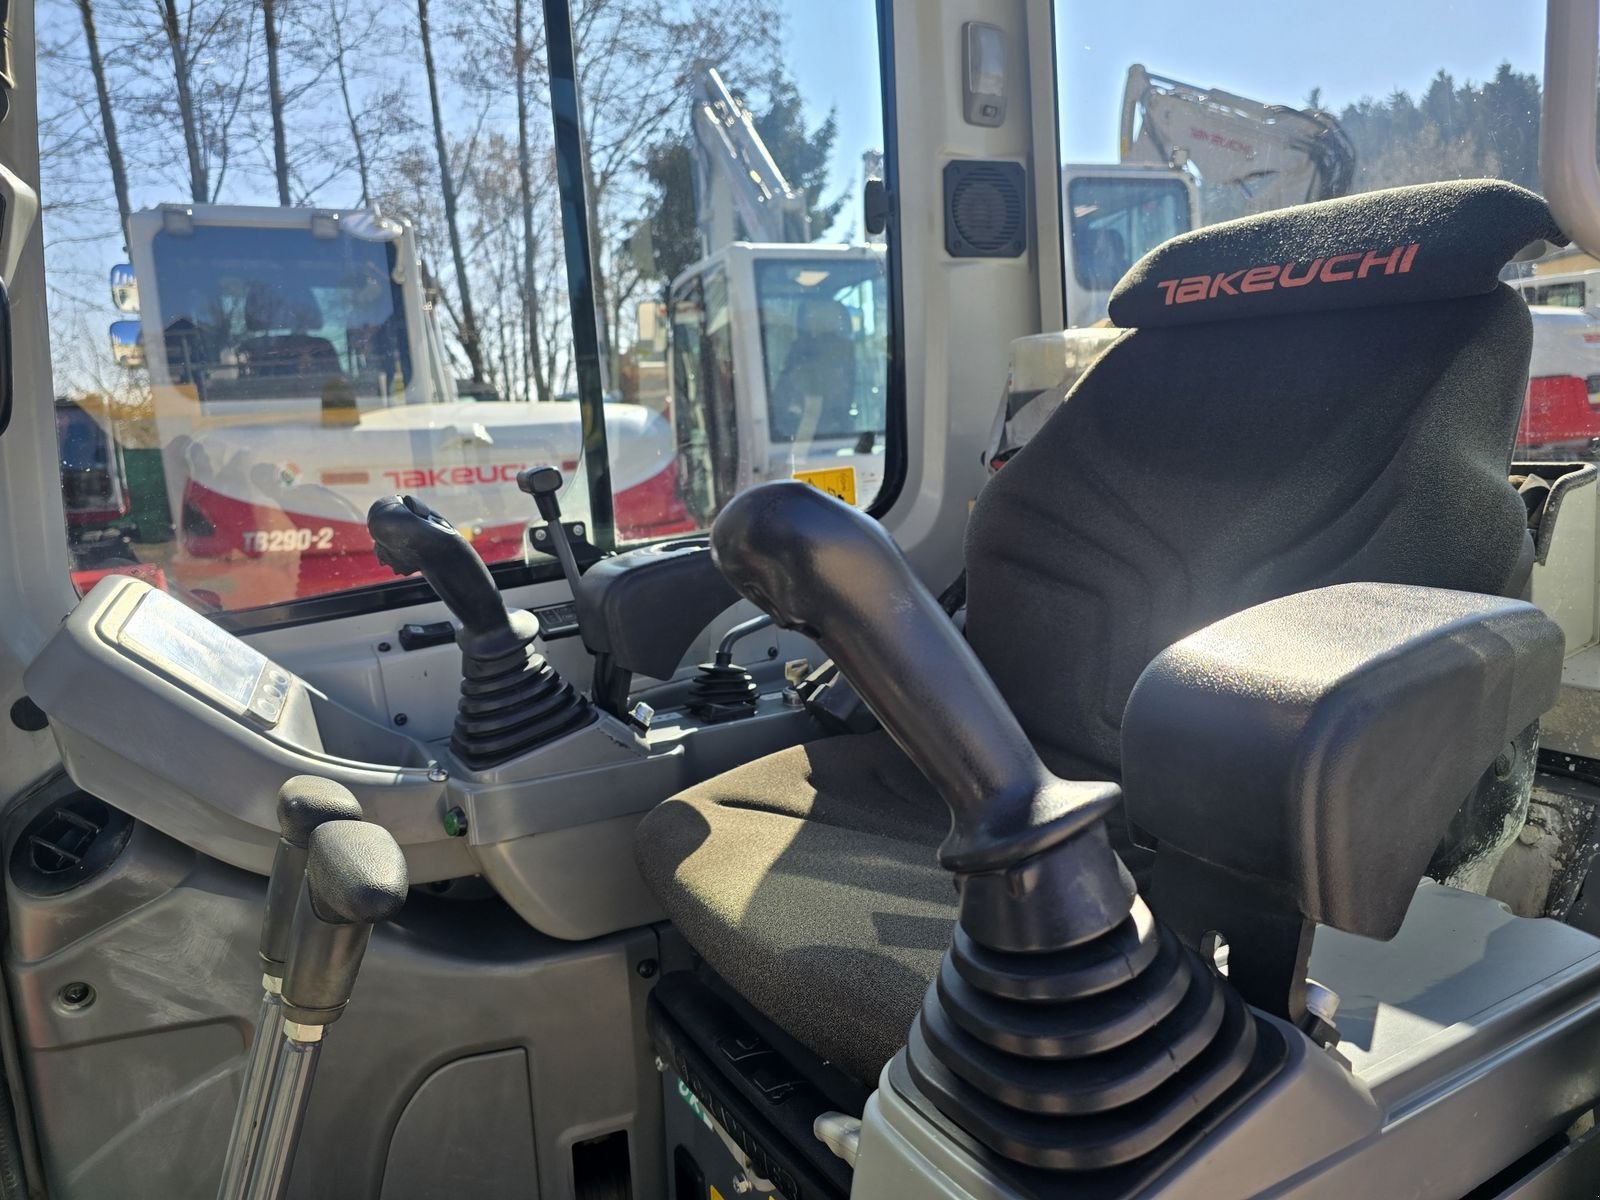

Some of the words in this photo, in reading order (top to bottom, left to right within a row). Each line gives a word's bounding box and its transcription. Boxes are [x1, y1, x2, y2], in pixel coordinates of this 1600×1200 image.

[1157, 243, 1420, 306] TAKEUCHI
[384, 463, 547, 490] TAKEUC
[243, 526, 335, 552] TB290-2
